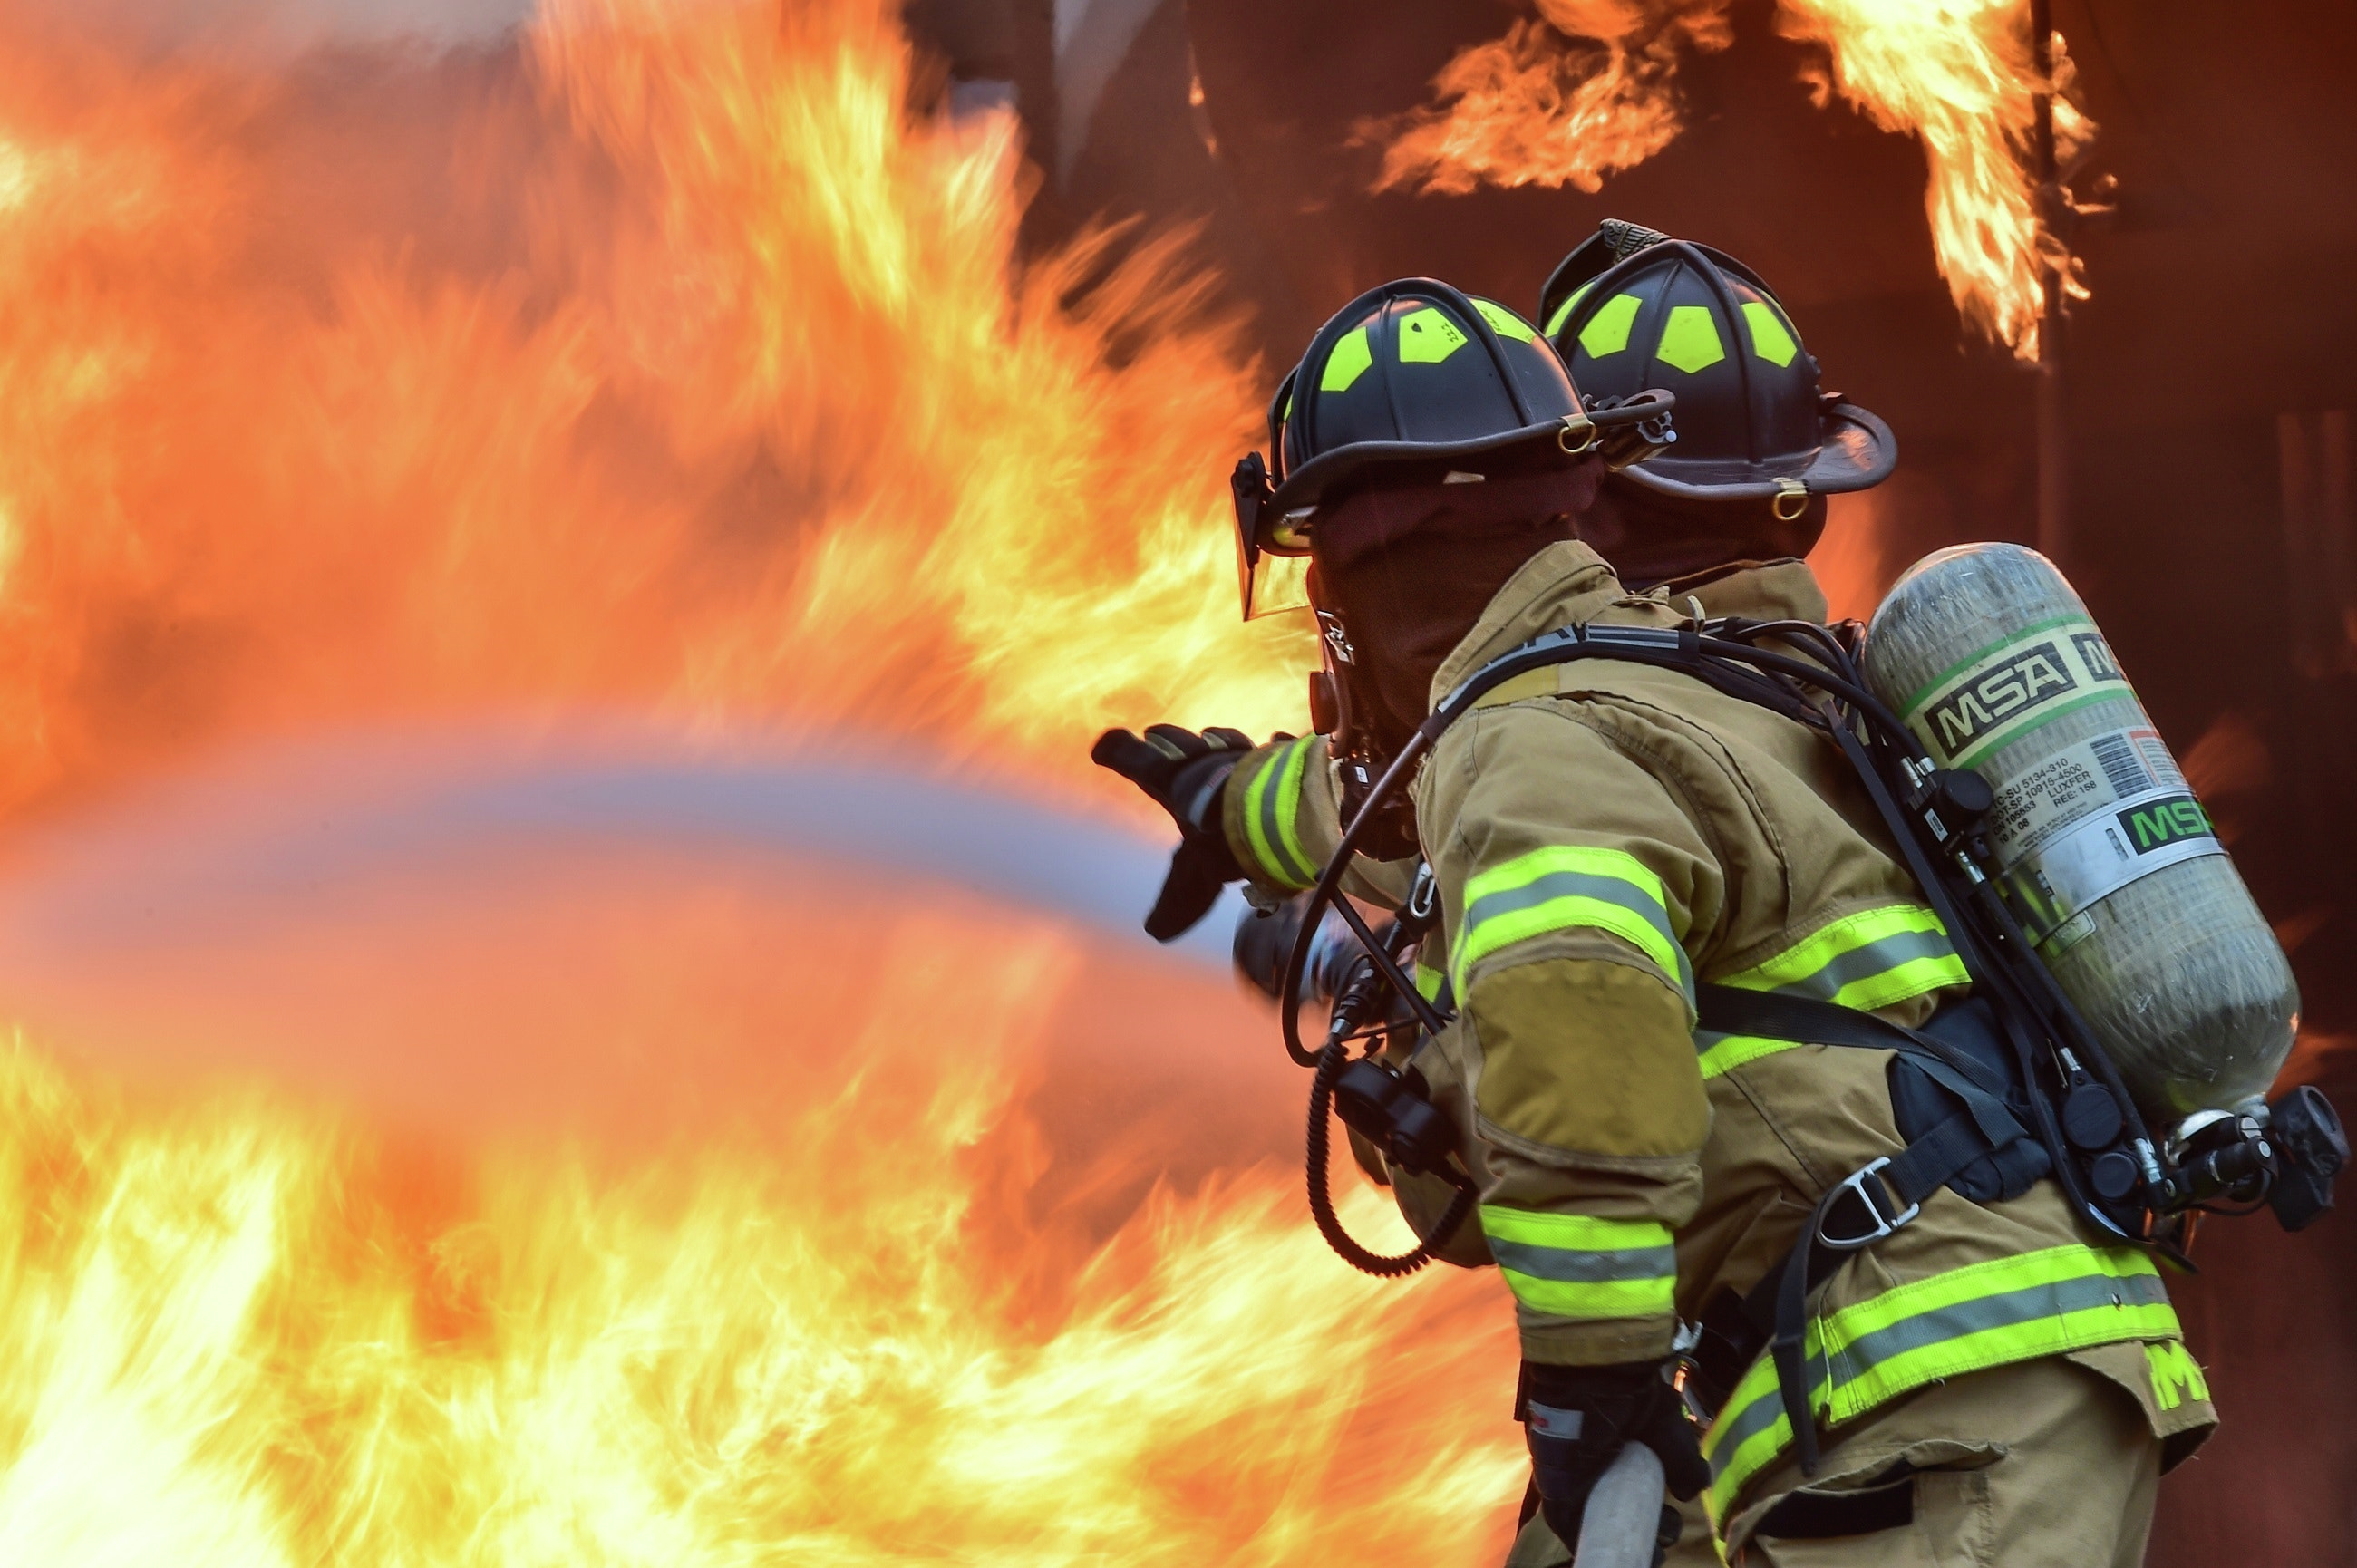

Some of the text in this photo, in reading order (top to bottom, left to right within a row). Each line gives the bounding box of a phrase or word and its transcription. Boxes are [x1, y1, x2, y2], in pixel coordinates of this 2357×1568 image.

[1936, 654, 2068, 749] MSA
[2005, 800, 2037, 826] 105653
[2047, 770, 2092, 799] LUXFER
[2022, 758, 2069, 788] 5134-310
[2025, 763, 2082, 800] 10915-4500
[2018, 818, 2030, 831] 08
[2053, 790, 2078, 808] REE:
[2080, 780, 2098, 794] 158
